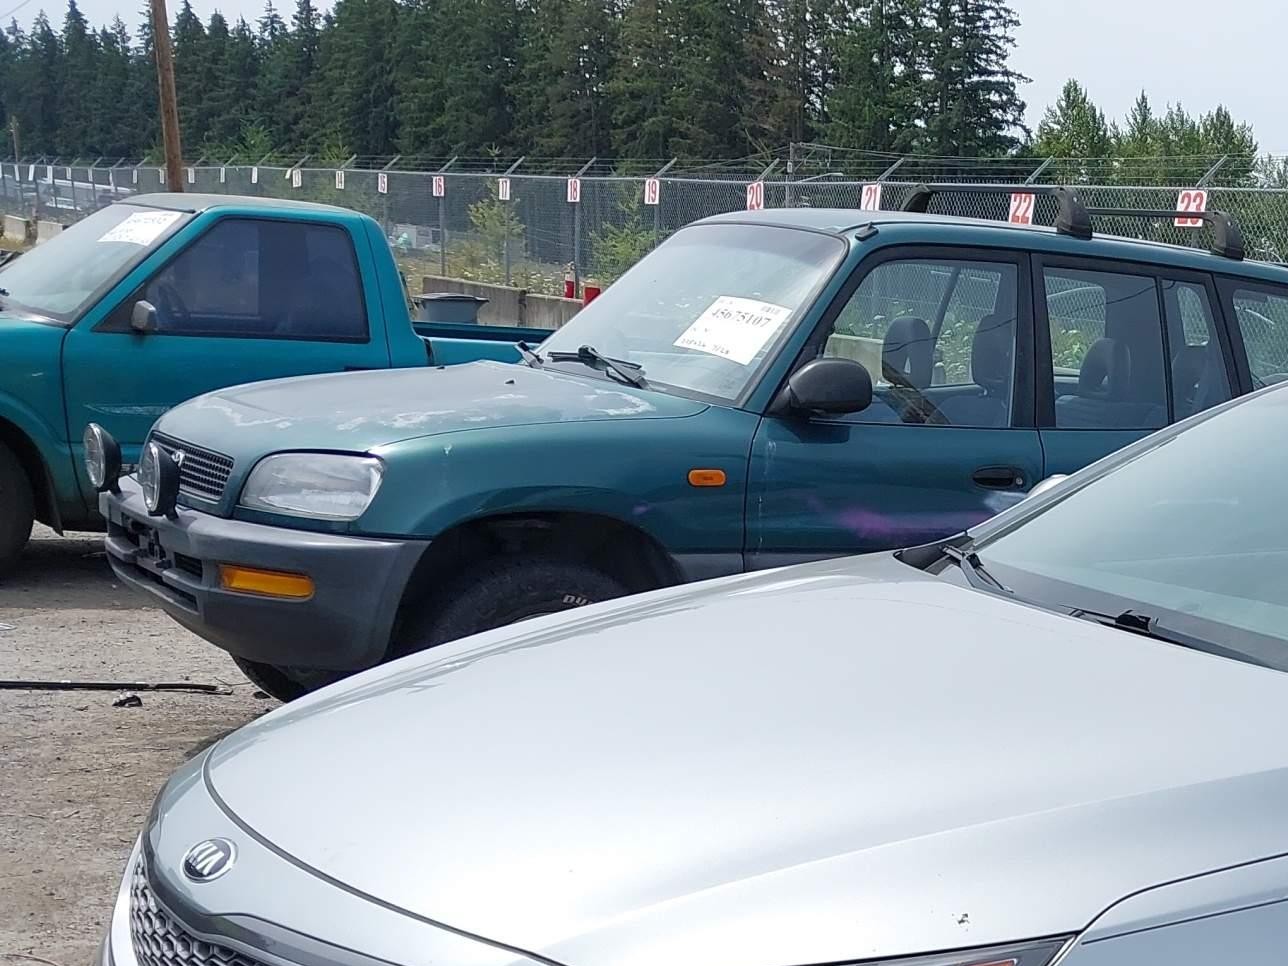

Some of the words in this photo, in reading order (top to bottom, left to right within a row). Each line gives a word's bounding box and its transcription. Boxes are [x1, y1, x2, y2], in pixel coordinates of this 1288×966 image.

[435, 177, 443, 195] 16
[569, 180, 578, 201] 18
[647, 180, 657, 203] 19
[748, 183, 762, 210] 20
[864, 186, 878, 211] 21
[1011, 193, 1032, 224] 22
[1176, 191, 1204, 225] 23
[562, 594, 594, 606] DU
